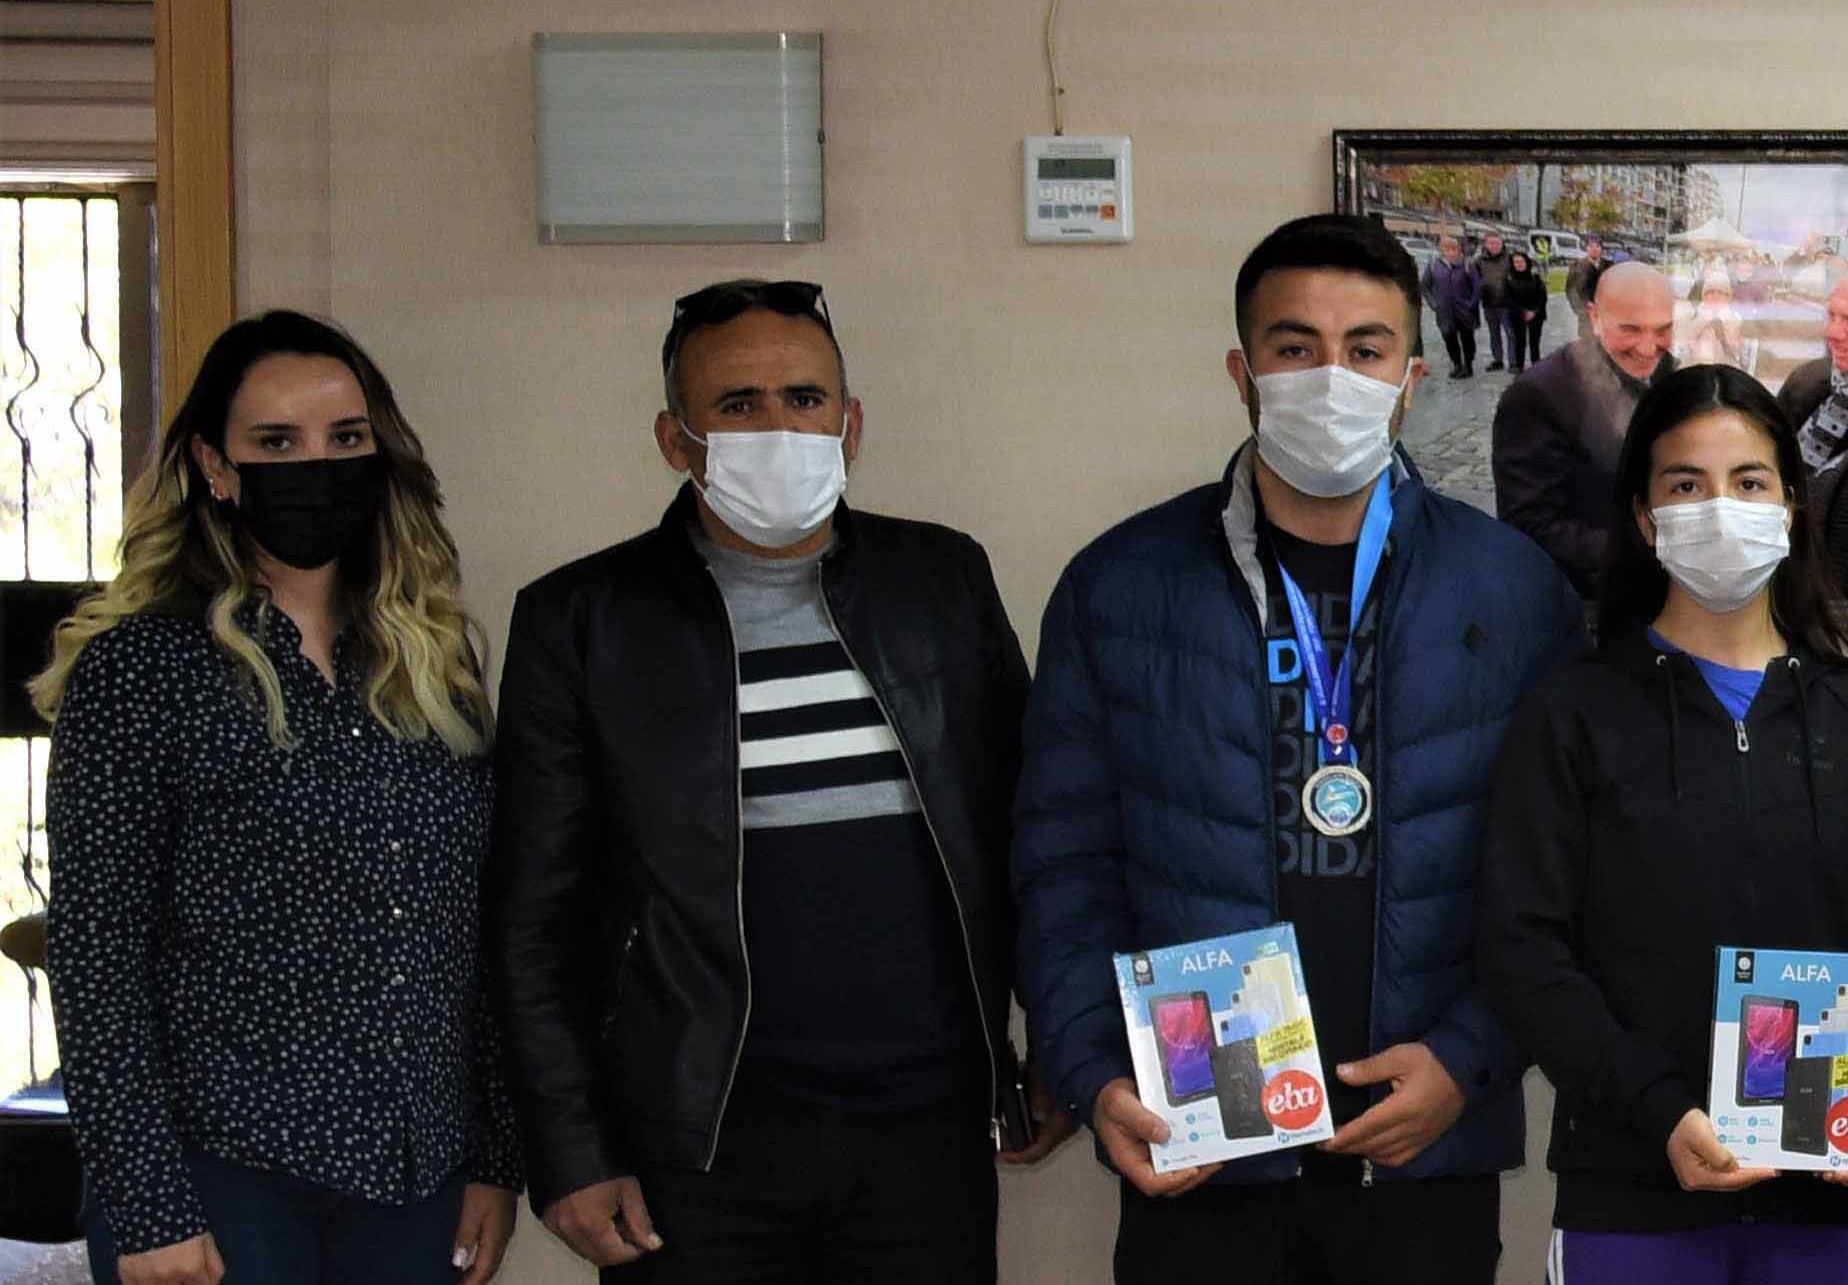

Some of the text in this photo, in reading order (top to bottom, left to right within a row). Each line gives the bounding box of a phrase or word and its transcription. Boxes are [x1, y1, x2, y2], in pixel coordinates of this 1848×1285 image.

[1181, 949, 1234, 976] ALFA
[1780, 963, 1832, 983] ALFA
[1267, 1081, 1319, 1115] eba
